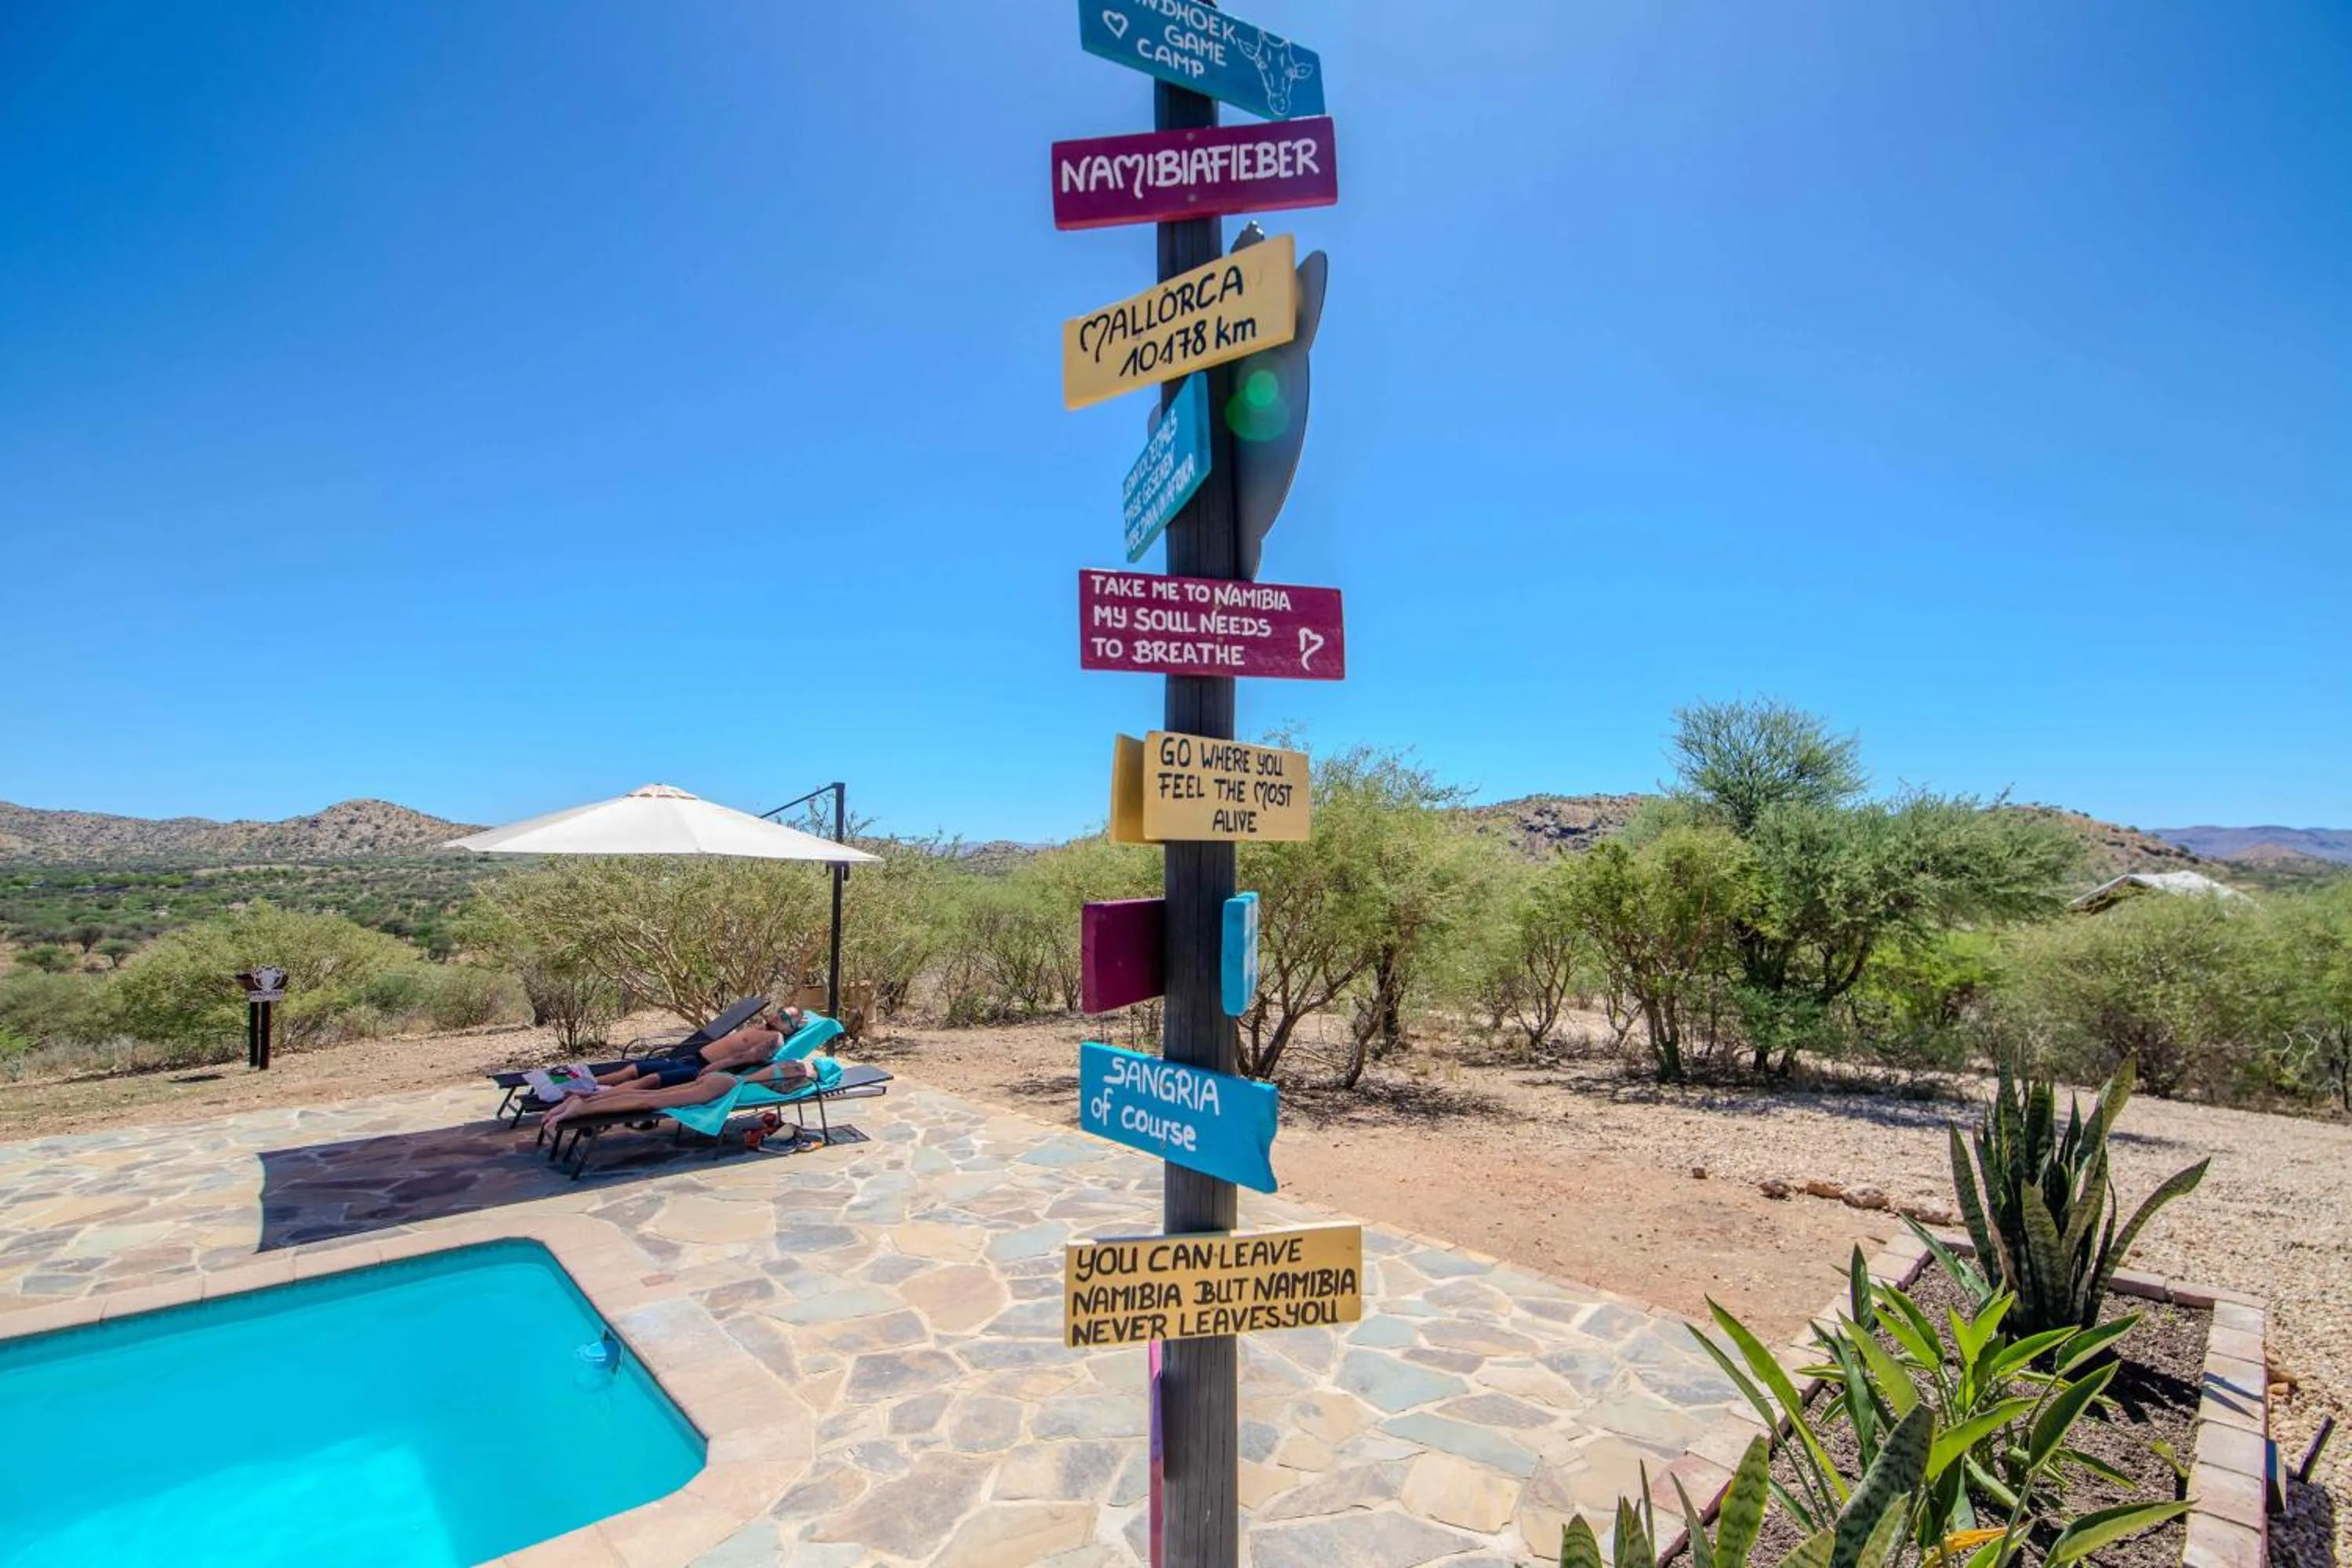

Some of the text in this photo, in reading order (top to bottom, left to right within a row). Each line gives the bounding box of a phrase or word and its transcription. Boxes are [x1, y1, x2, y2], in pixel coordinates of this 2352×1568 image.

[1134, 0, 1236, 45] NDHOEK
[1138, 38, 1204, 78] CAMP
[1164, 24, 1227, 67] GAME
[1062, 138, 1319, 198] NAMIBIAFIEBER
[1080, 264, 1243, 362] MALLORCA
[1216, 315, 1256, 350] km
[1091, 575, 1291, 611] TAKE ME TO NAMIBIA
[1094, 605, 1272, 637] MY SOUL NEEDS
[1091, 637, 1245, 666] TO BREATHE
[1160, 737, 1283, 777] GO WHERE YOU
[1158, 772, 1293, 811] FEEL THE MOST
[1212, 808, 1257, 833] ALIVE
[1091, 1087, 1114, 1126] of
[1103, 1057, 1221, 1116] SANGRIA
[1075, 1238, 1304, 1283] YOU CAN LEAVE
[1072, 1268, 1357, 1316] NAMIBIA BUT NAMIBIA
[1072, 1298, 1339, 1347] NEVER LEAVES YOU
